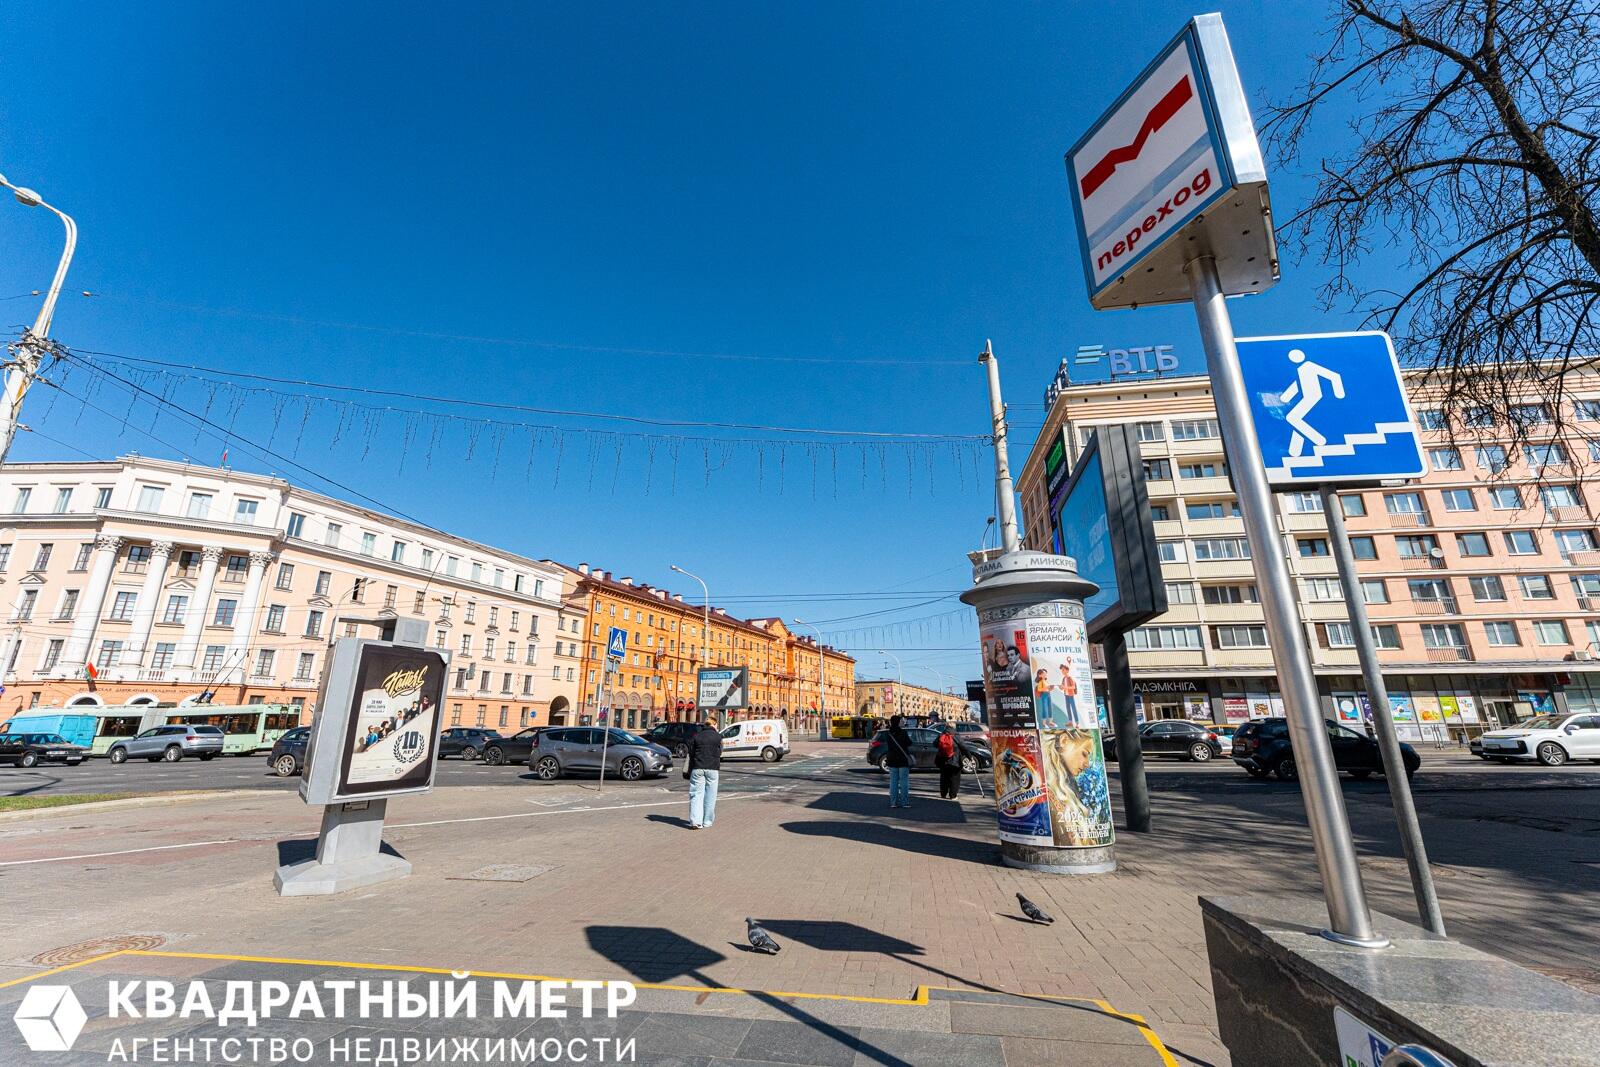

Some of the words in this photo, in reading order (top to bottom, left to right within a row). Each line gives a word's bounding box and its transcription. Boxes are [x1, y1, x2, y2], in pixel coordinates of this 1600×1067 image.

[1108, 344, 1180, 375] ВТБ
[1015, 630, 1025, 640] 16
[1029, 626, 1067, 634] ЯРМАРКА
[1030, 633, 1073, 642] ВАКАНСИЙ
[1031, 646, 1051, 654] 15-17
[1053, 645, 1082, 654] АПРЕЛЯ
[402, 731, 419, 750] 10
[1057, 811, 1084, 823] 2026
